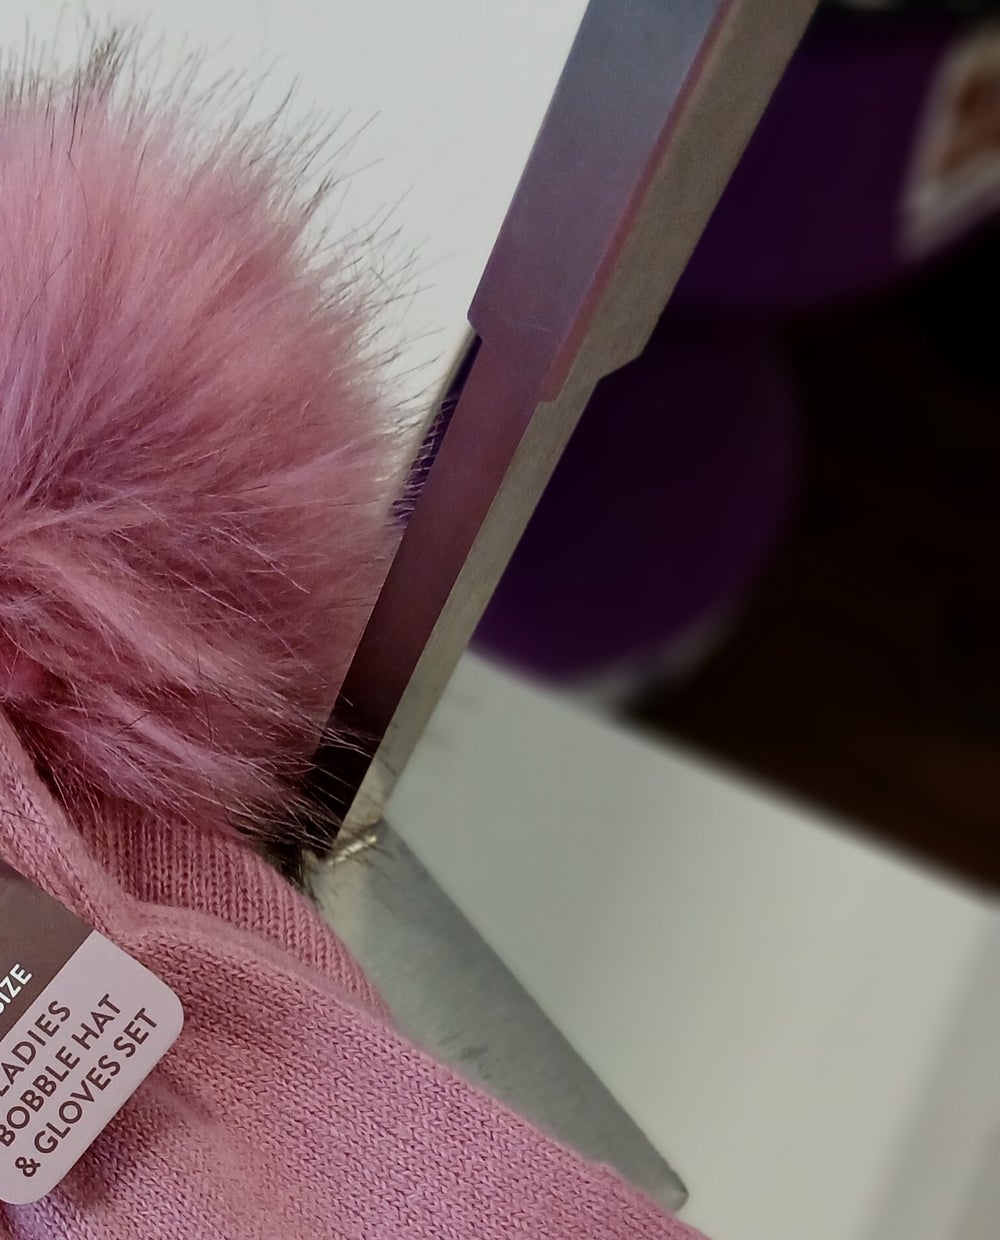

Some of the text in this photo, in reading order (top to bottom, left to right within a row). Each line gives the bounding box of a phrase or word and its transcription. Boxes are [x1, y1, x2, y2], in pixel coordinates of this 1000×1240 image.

[71, 993, 121, 1050] HAT
[15, 1007, 157, 1177] & GLOVES SET
